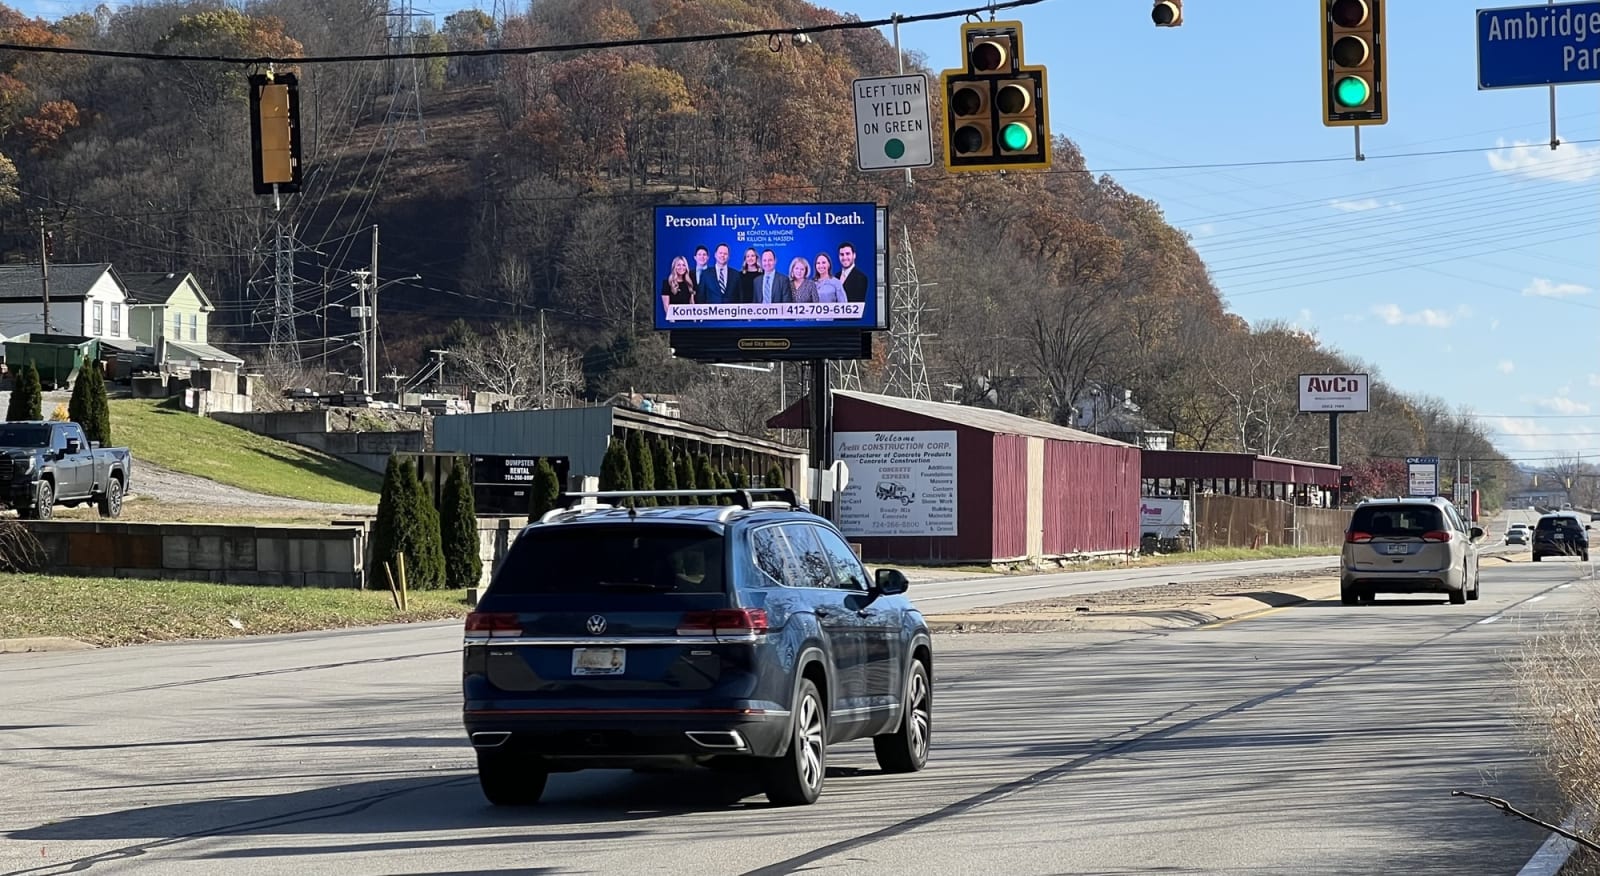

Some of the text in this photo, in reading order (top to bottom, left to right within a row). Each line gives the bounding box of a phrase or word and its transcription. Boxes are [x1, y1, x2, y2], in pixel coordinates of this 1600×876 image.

[1488, 8, 1600, 42] Ambridge
[860, 83, 920, 98] LEFT TURN
[872, 101, 911, 117] YIELD
[864, 120, 922, 135] ON GREEN
[666, 212, 864, 229] Personal Injury. Wrongful Death.
[672, 304, 860, 317] KontosMengine.com 412-709-6162
[1308, 377, 1358, 392] AvCo
[874, 433, 914, 442] Welcome
[862, 443, 924, 451] CONSTRUCTION
[927, 442, 951, 450] CORP.
